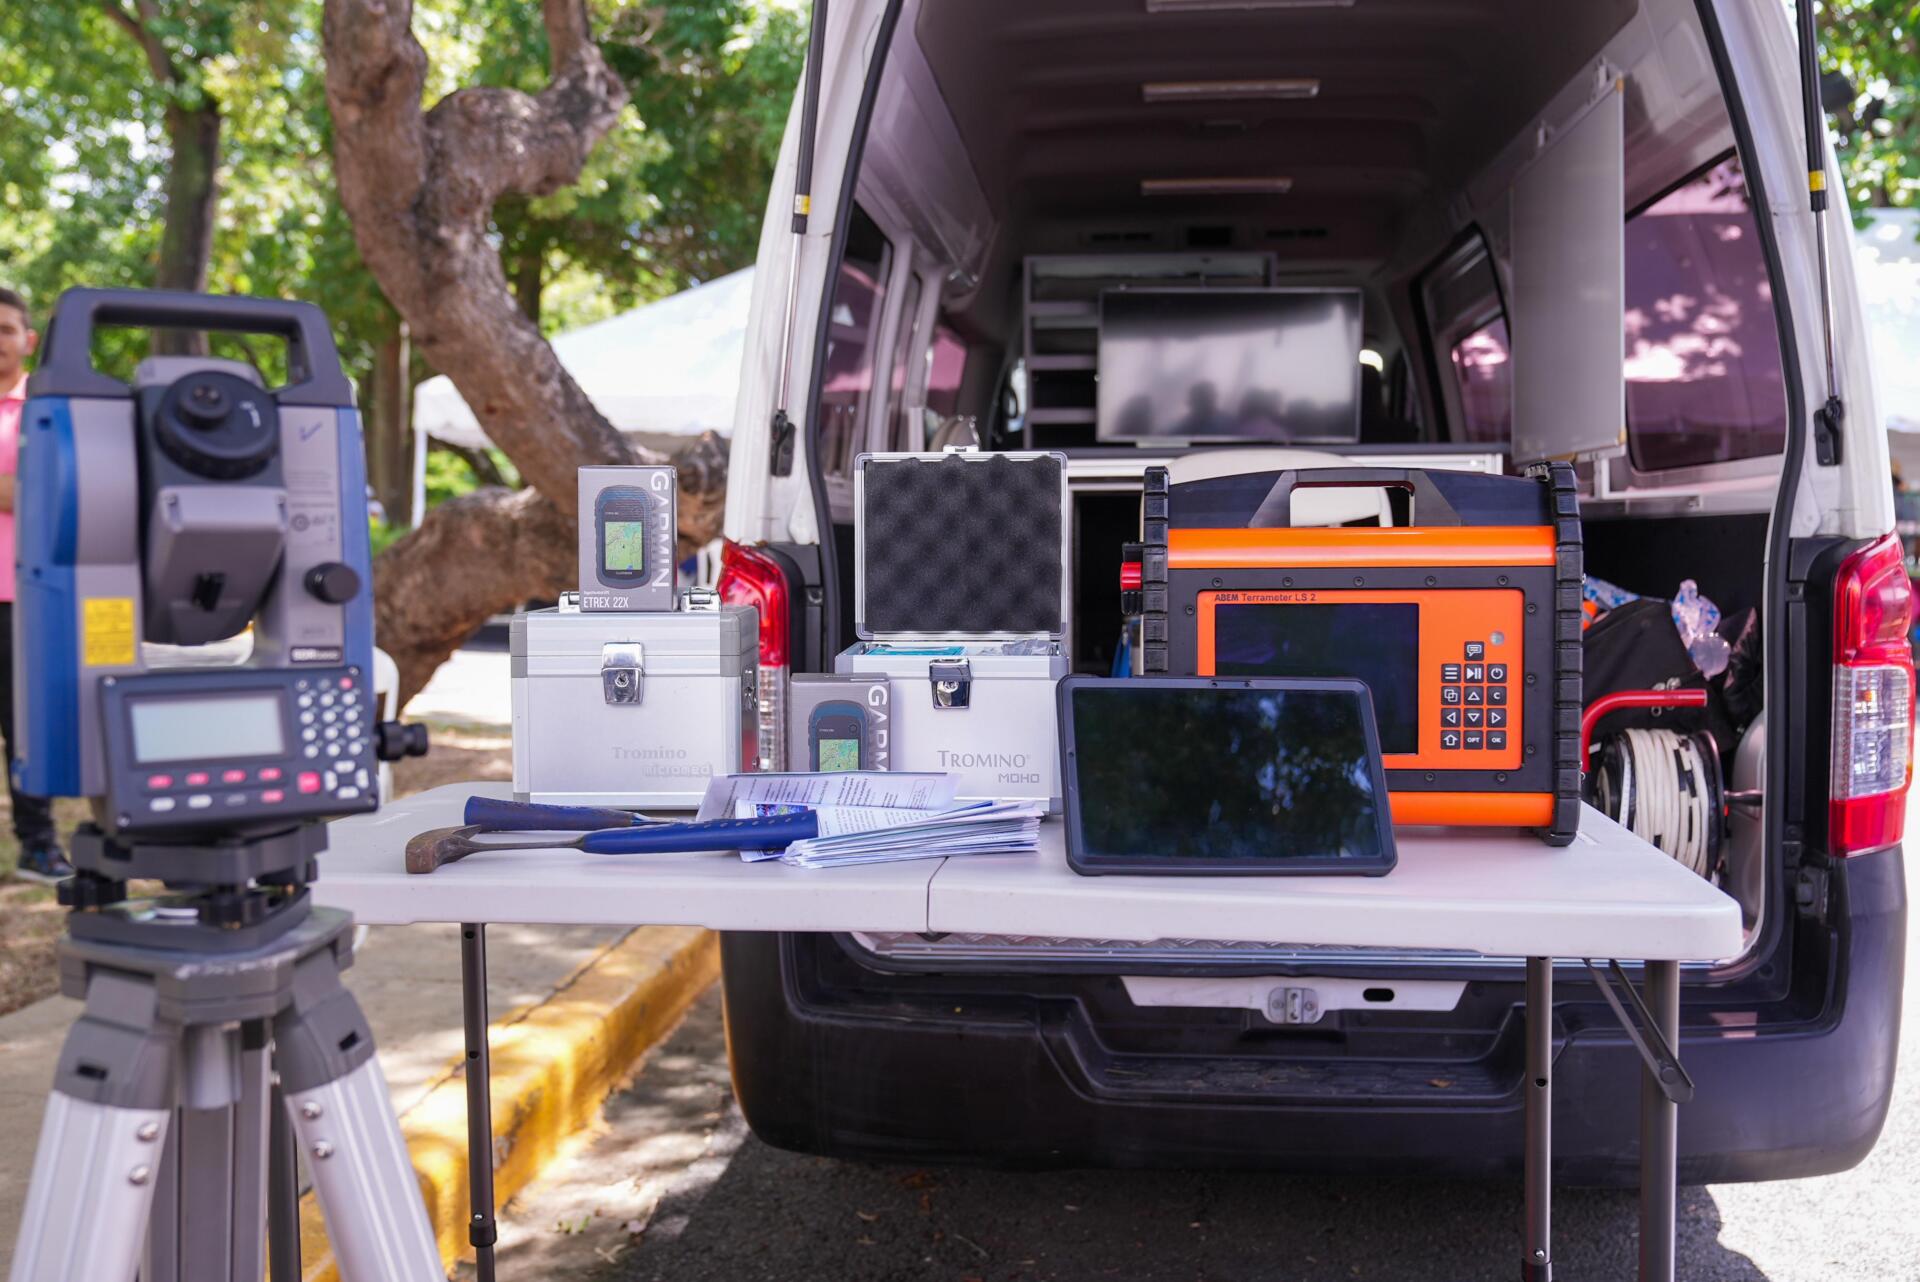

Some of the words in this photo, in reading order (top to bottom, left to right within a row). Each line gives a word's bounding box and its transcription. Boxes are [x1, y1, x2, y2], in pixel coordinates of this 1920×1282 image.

[650, 471, 670, 588] GARMIN
[583, 597, 610, 608] ETREX
[612, 597, 629, 608] 22X
[1215, 593, 1239, 602] ABEM
[1241, 593, 1292, 602] Terrameter
[1295, 593, 1308, 601] LS
[1311, 593, 1317, 601] 2
[1493, 692, 1501, 700] C
[867, 685, 888, 772] GARM
[611, 746, 687, 760] Tromino
[937, 750, 1026, 768] TROMINO
[998, 773, 1040, 784] MOHO
